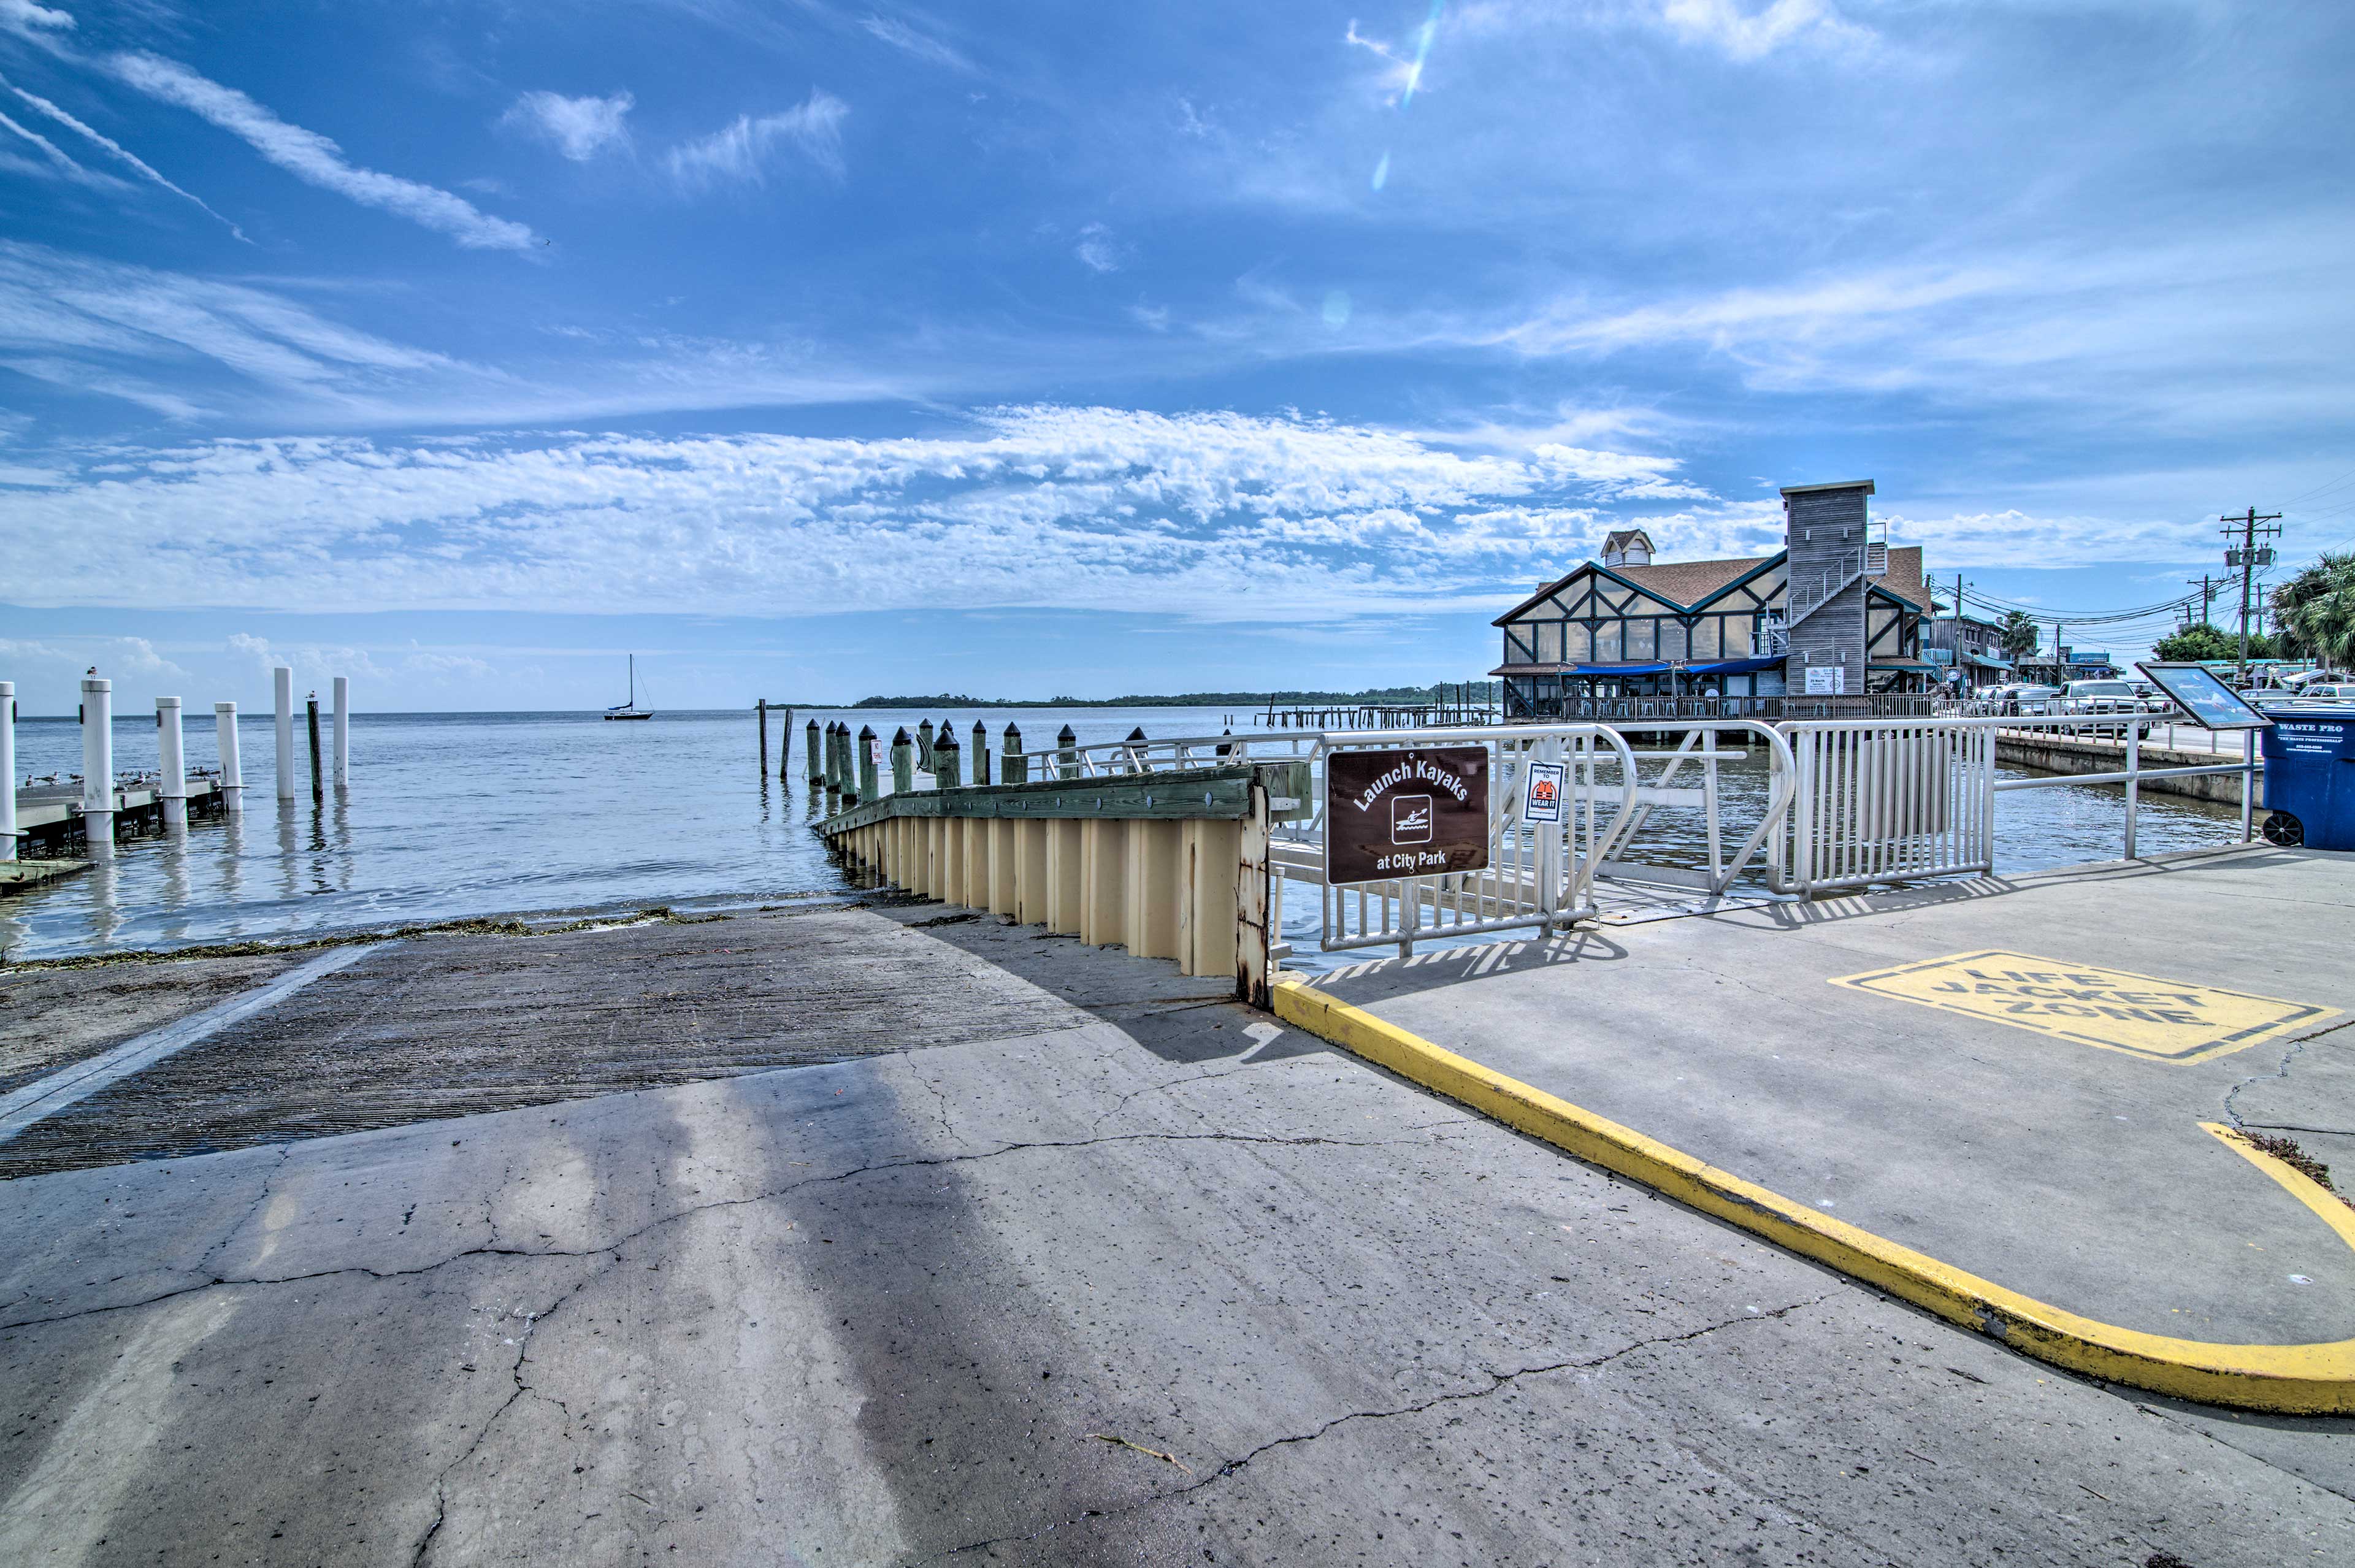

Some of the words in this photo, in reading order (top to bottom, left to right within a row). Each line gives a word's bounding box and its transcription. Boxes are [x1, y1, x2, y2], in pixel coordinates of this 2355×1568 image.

[1353, 762, 1411, 813] Launch
[1416, 760, 1468, 801] Kayaks
[1532, 798, 1549, 807] WEAR
[1377, 855, 1390, 870] at
[1393, 853, 1416, 868] City
[1418, 850, 1446, 865] Park
[1963, 969, 2118, 987] LIFE
[1931, 981, 2208, 1008] JACKET
[1993, 1000, 2217, 1025] ZONE
